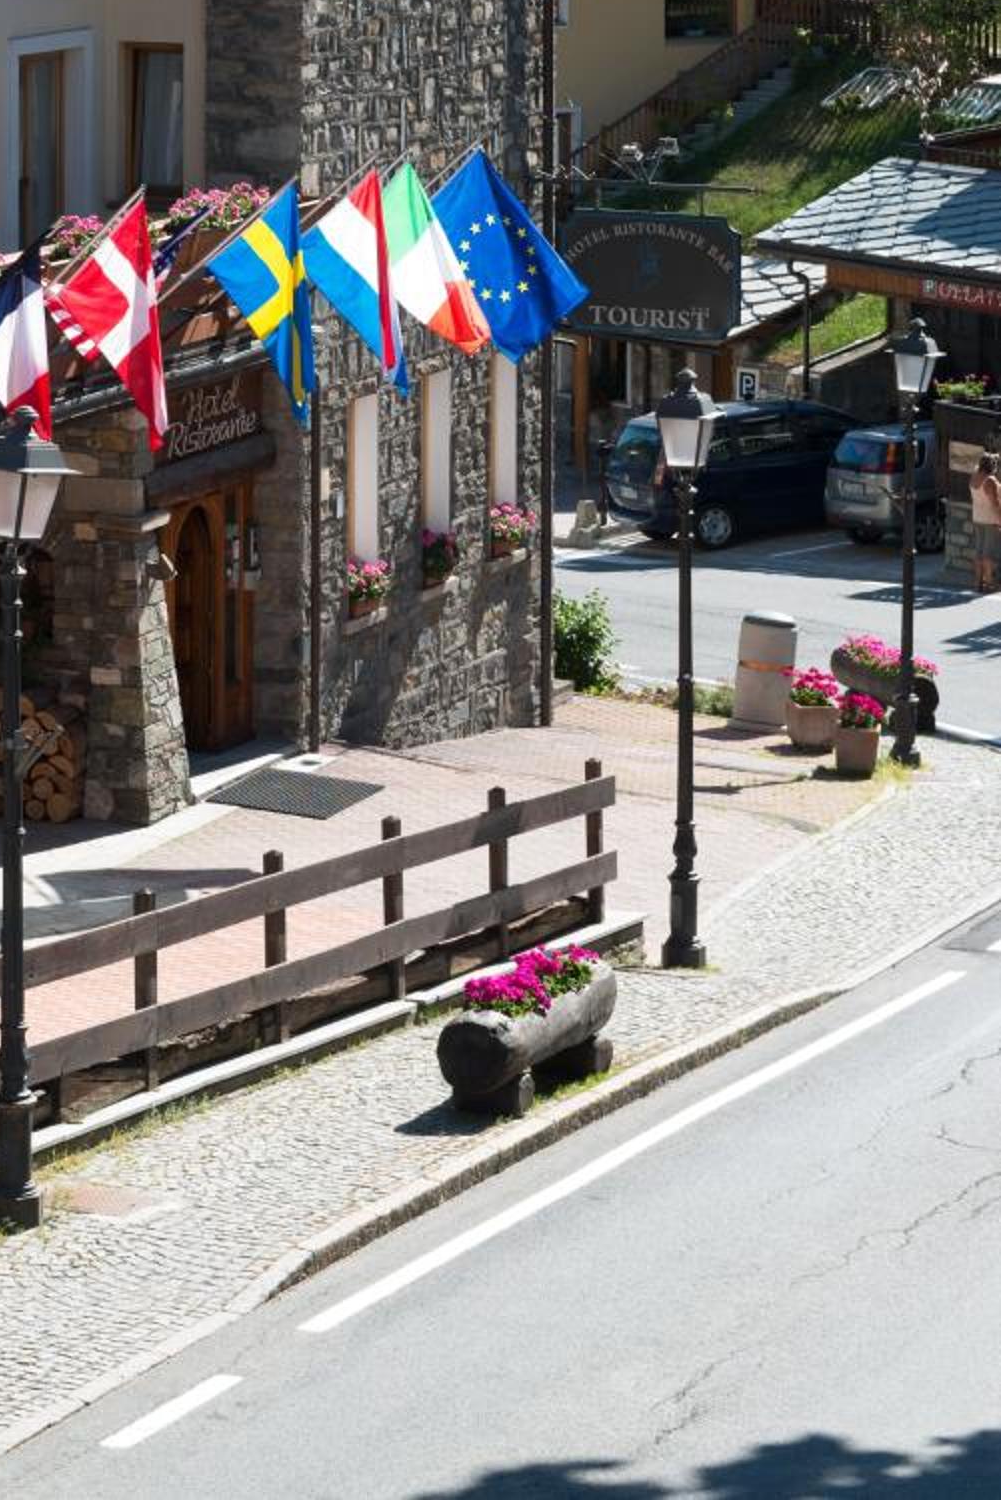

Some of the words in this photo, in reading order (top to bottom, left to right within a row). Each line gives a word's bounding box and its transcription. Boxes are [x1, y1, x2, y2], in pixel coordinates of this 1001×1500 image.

[566, 229, 609, 262] HOTEL
[614, 222, 707, 250] RISTORANTE
[706, 245, 734, 276] BAR
[588, 304, 710, 331] TOURIST
[183, 376, 240, 424] Hotel
[742, 374, 754, 395] P
[166, 409, 256, 458] Ristorante
